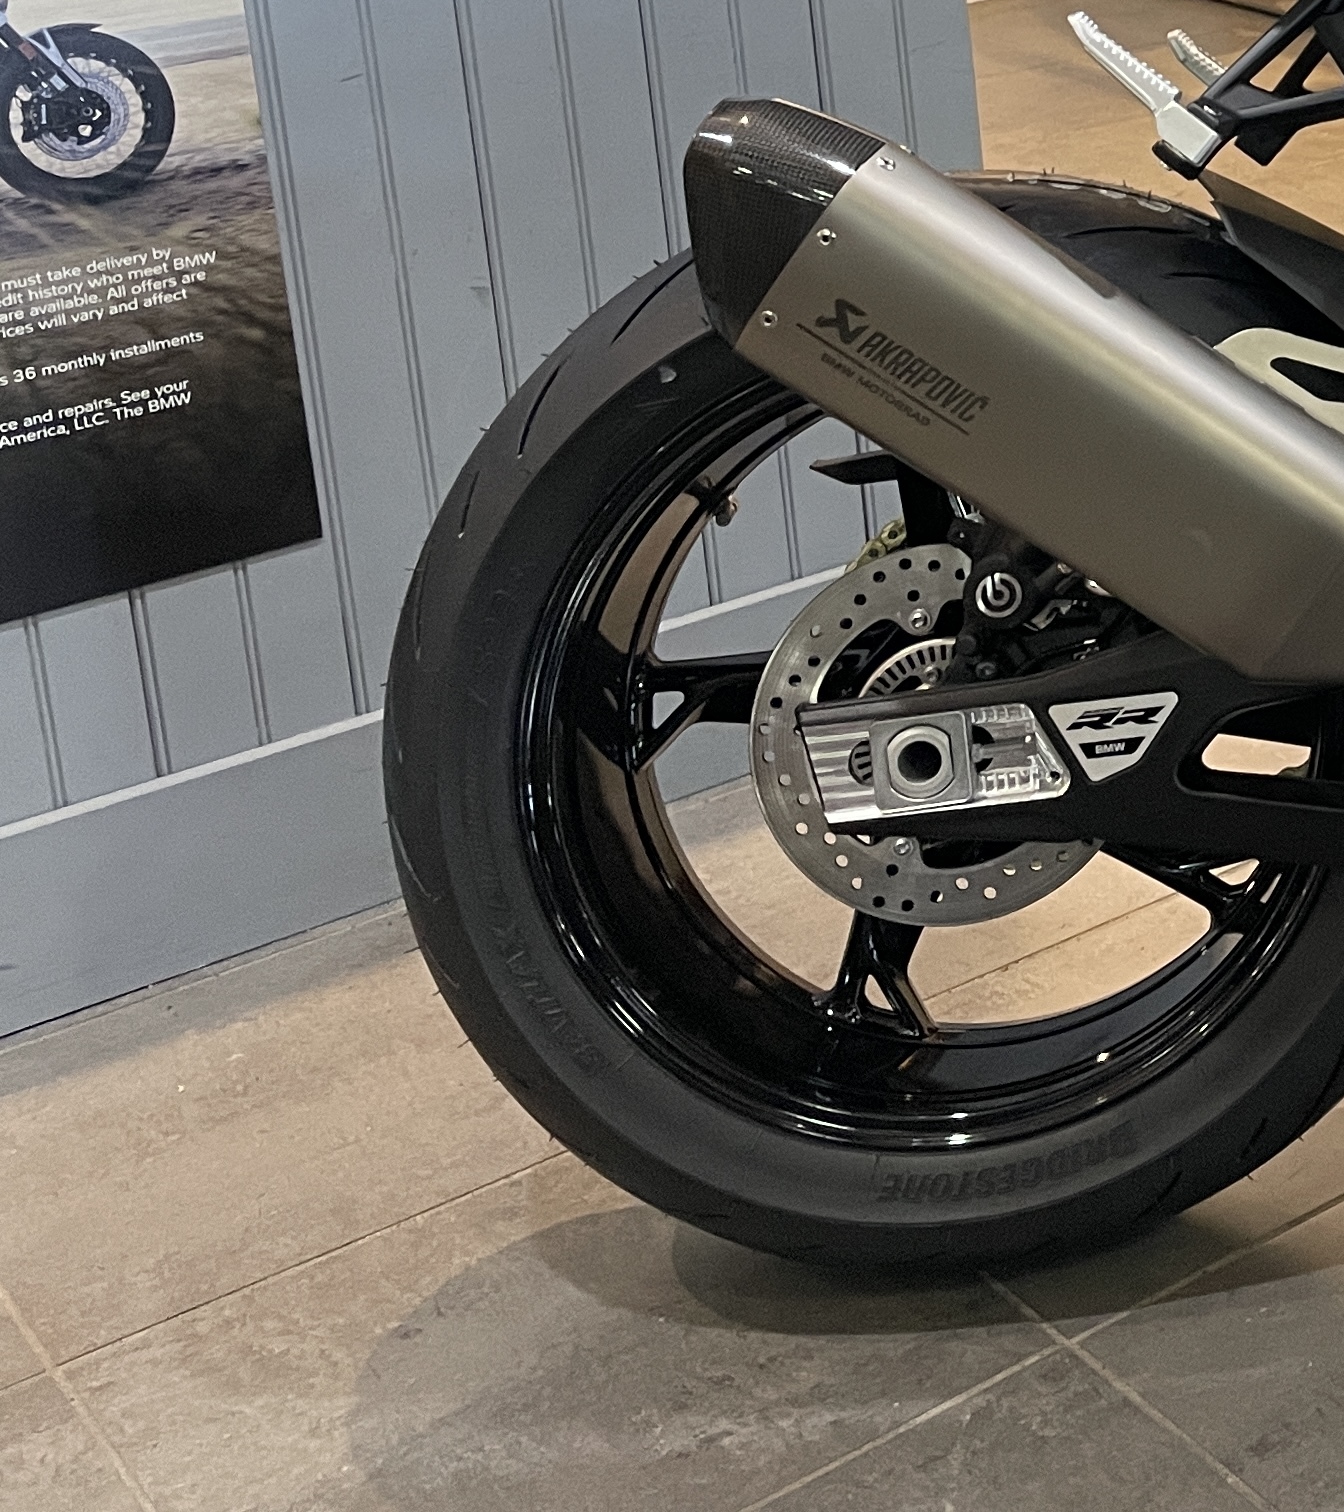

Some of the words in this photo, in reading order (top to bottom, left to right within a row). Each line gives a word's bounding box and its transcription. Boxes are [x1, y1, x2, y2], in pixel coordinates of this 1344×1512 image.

[0, 291, 24, 308] dit
[28, 281, 83, 302] history
[88, 273, 123, 289] who
[128, 262, 169, 281] meet
[173, 250, 216, 271] BMW
[2, 273, 42, 292] must
[47, 266, 81, 282] take
[86, 252, 148, 274] delivery
[152, 247, 171, 262] by
[29, 293, 102, 318] available.
[107, 285, 126, 301] All
[131, 276, 177, 295] offers
[181, 270, 206, 285] are
[0, 321, 34, 339] ices
[38, 313, 67, 331] will
[71, 306, 104, 325] vary
[109, 298, 139, 316] and
[143, 288, 188, 308] affect
[13, 366, 36, 383] 36
[41, 352, 105, 377] monthly
[109, 331, 204, 361] installments
[0, 424, 70, 450] America,
[74, 411, 109, 431] LLC.
[113, 404, 143, 421] The
[147, 391, 192, 414] BMW
[23, 409, 53, 428] and
[58, 395, 116, 420] repairs.
[120, 388, 150, 405] See
[154, 379, 189, 398] your
[1095, 742, 1126, 755] BMW
